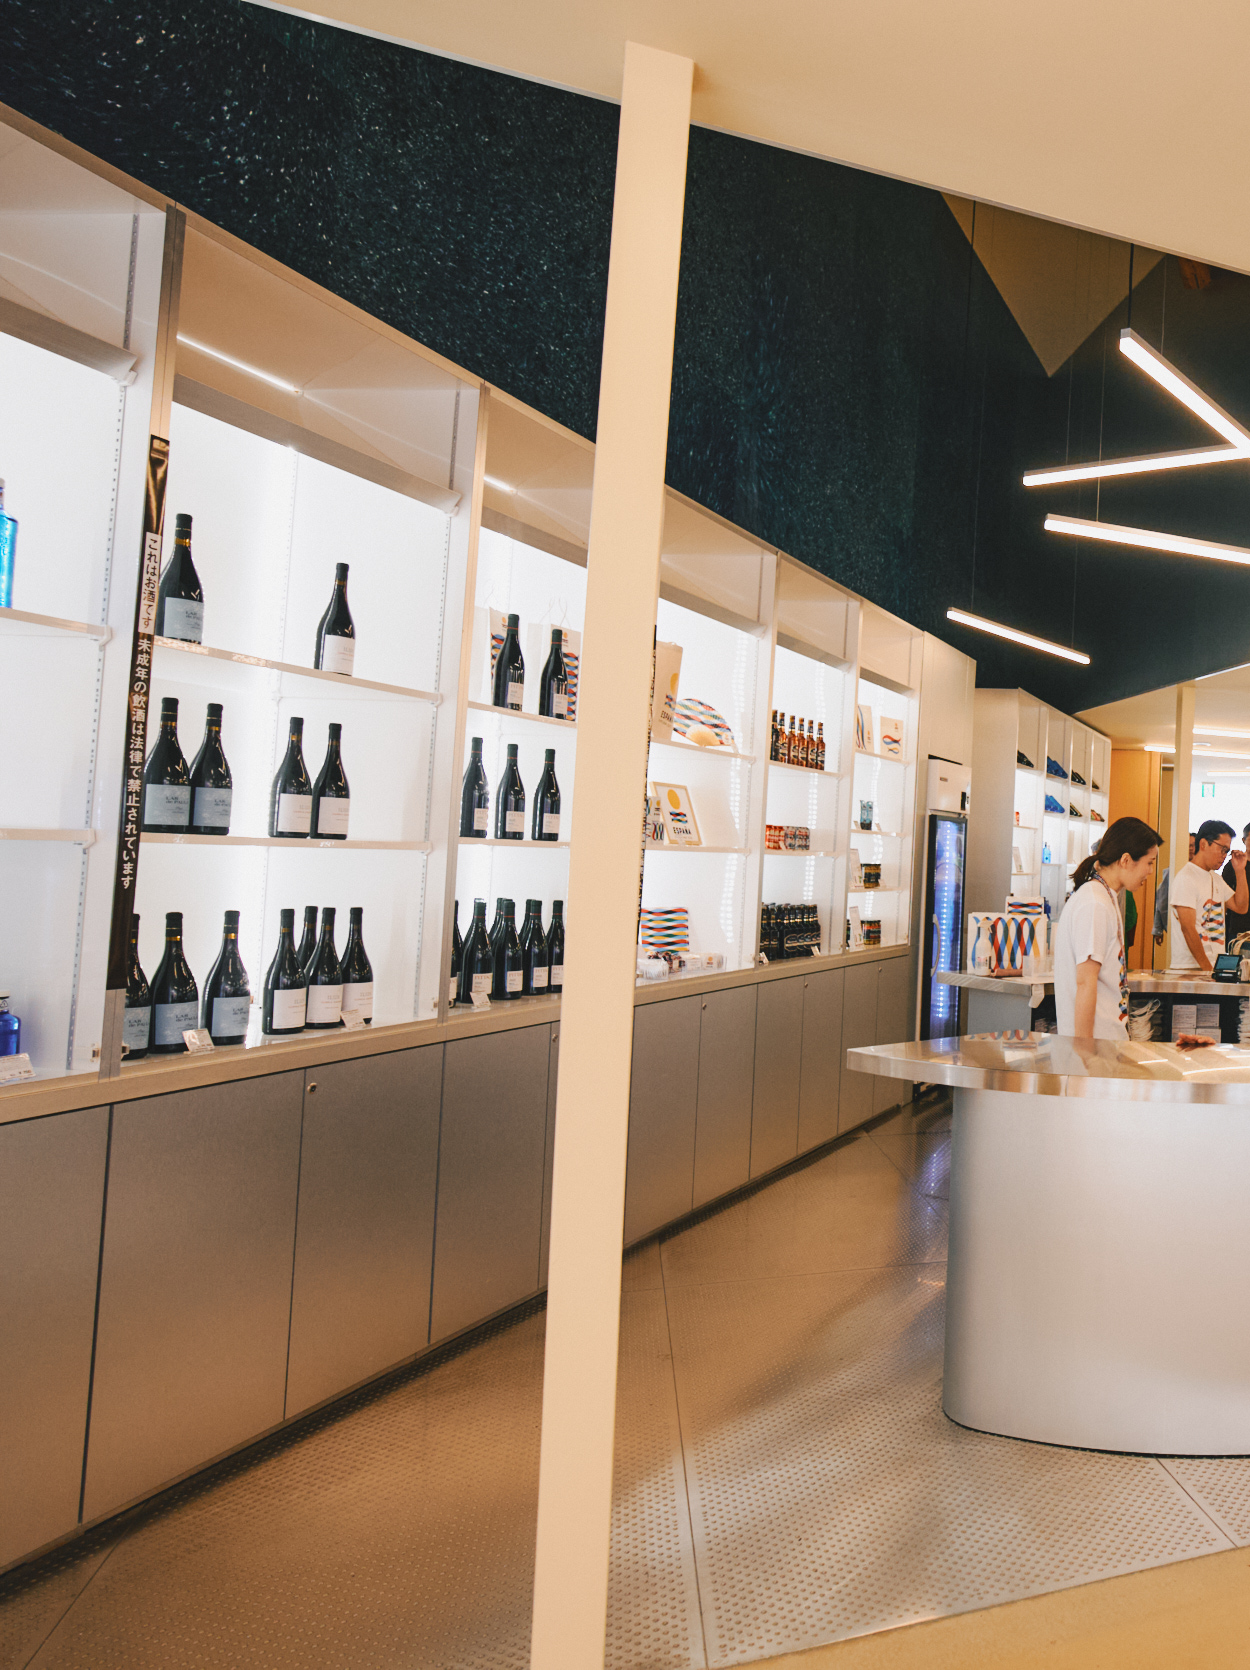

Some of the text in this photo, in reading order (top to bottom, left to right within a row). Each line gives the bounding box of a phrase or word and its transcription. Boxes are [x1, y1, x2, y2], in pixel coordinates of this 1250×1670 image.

[142, 538, 159, 629] これはお酒です
[121, 638, 152, 890] 未成年の飲酒は法律で禁止されています
